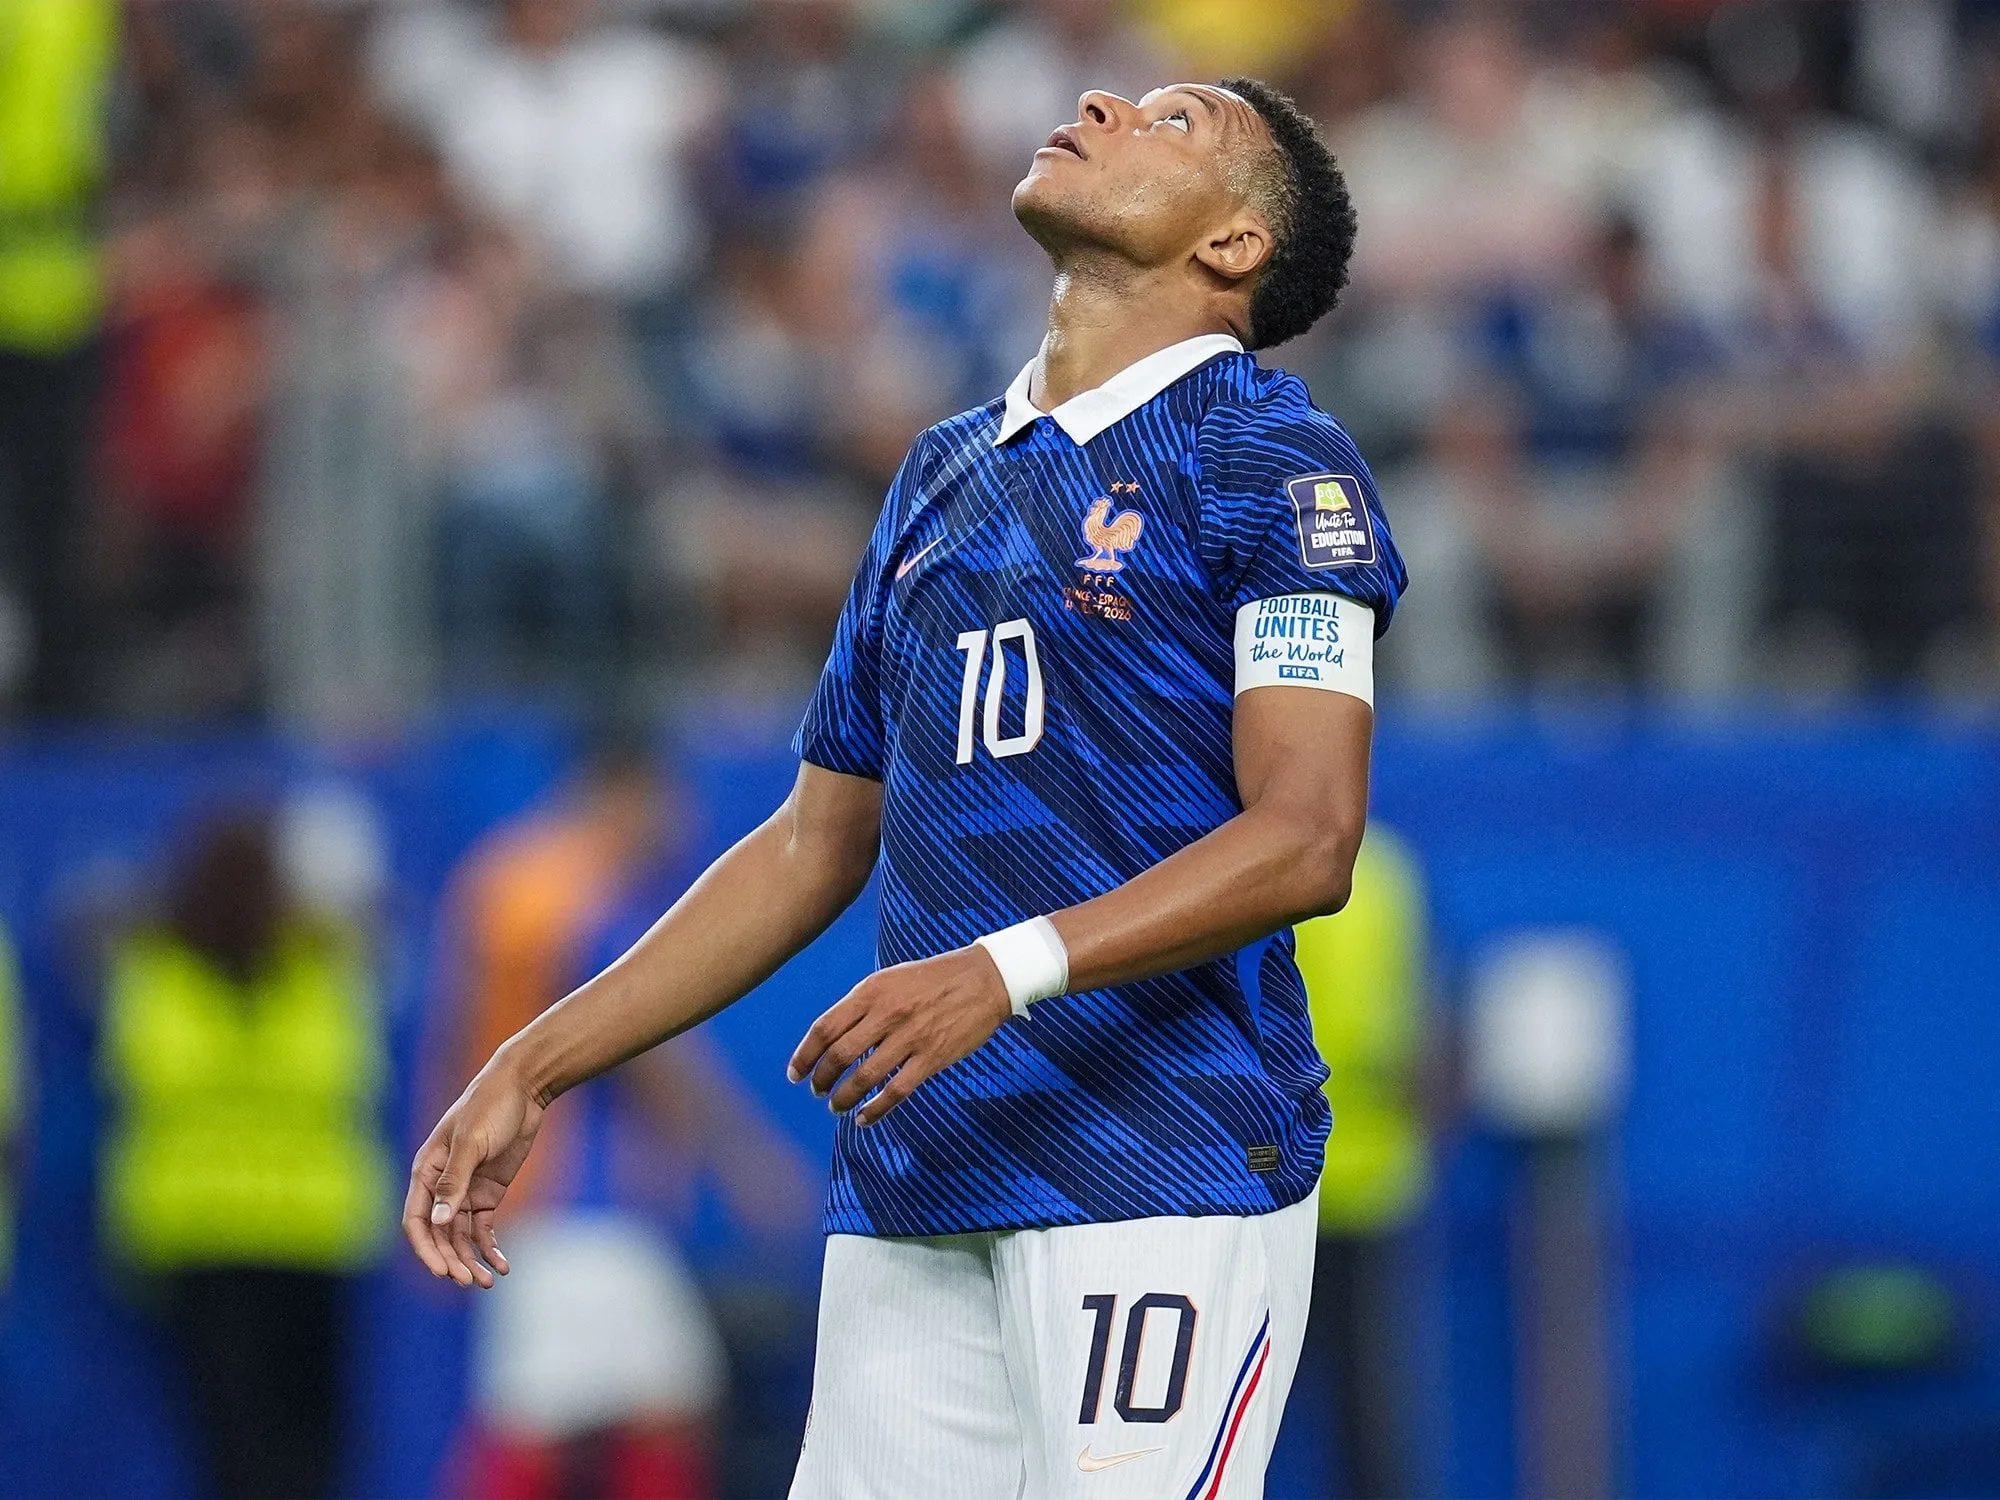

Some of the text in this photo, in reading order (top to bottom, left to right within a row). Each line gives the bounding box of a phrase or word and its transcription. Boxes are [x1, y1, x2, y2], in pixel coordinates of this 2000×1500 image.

[1315, 511, 1356, 531] Unite For
[1311, 529, 1366, 549] EDUCATION
[1331, 547, 1354, 557] FIFA
[1104, 606, 1132, 620] 2026
[1258, 597, 1340, 619] FOOTBALL
[1254, 616, 1339, 643] UNITES
[1249, 641, 1345, 669] the World
[1281, 666, 1318, 679] FIFA
[955, 618, 1045, 765] 10
[1078, 1292, 1199, 1425] 10
